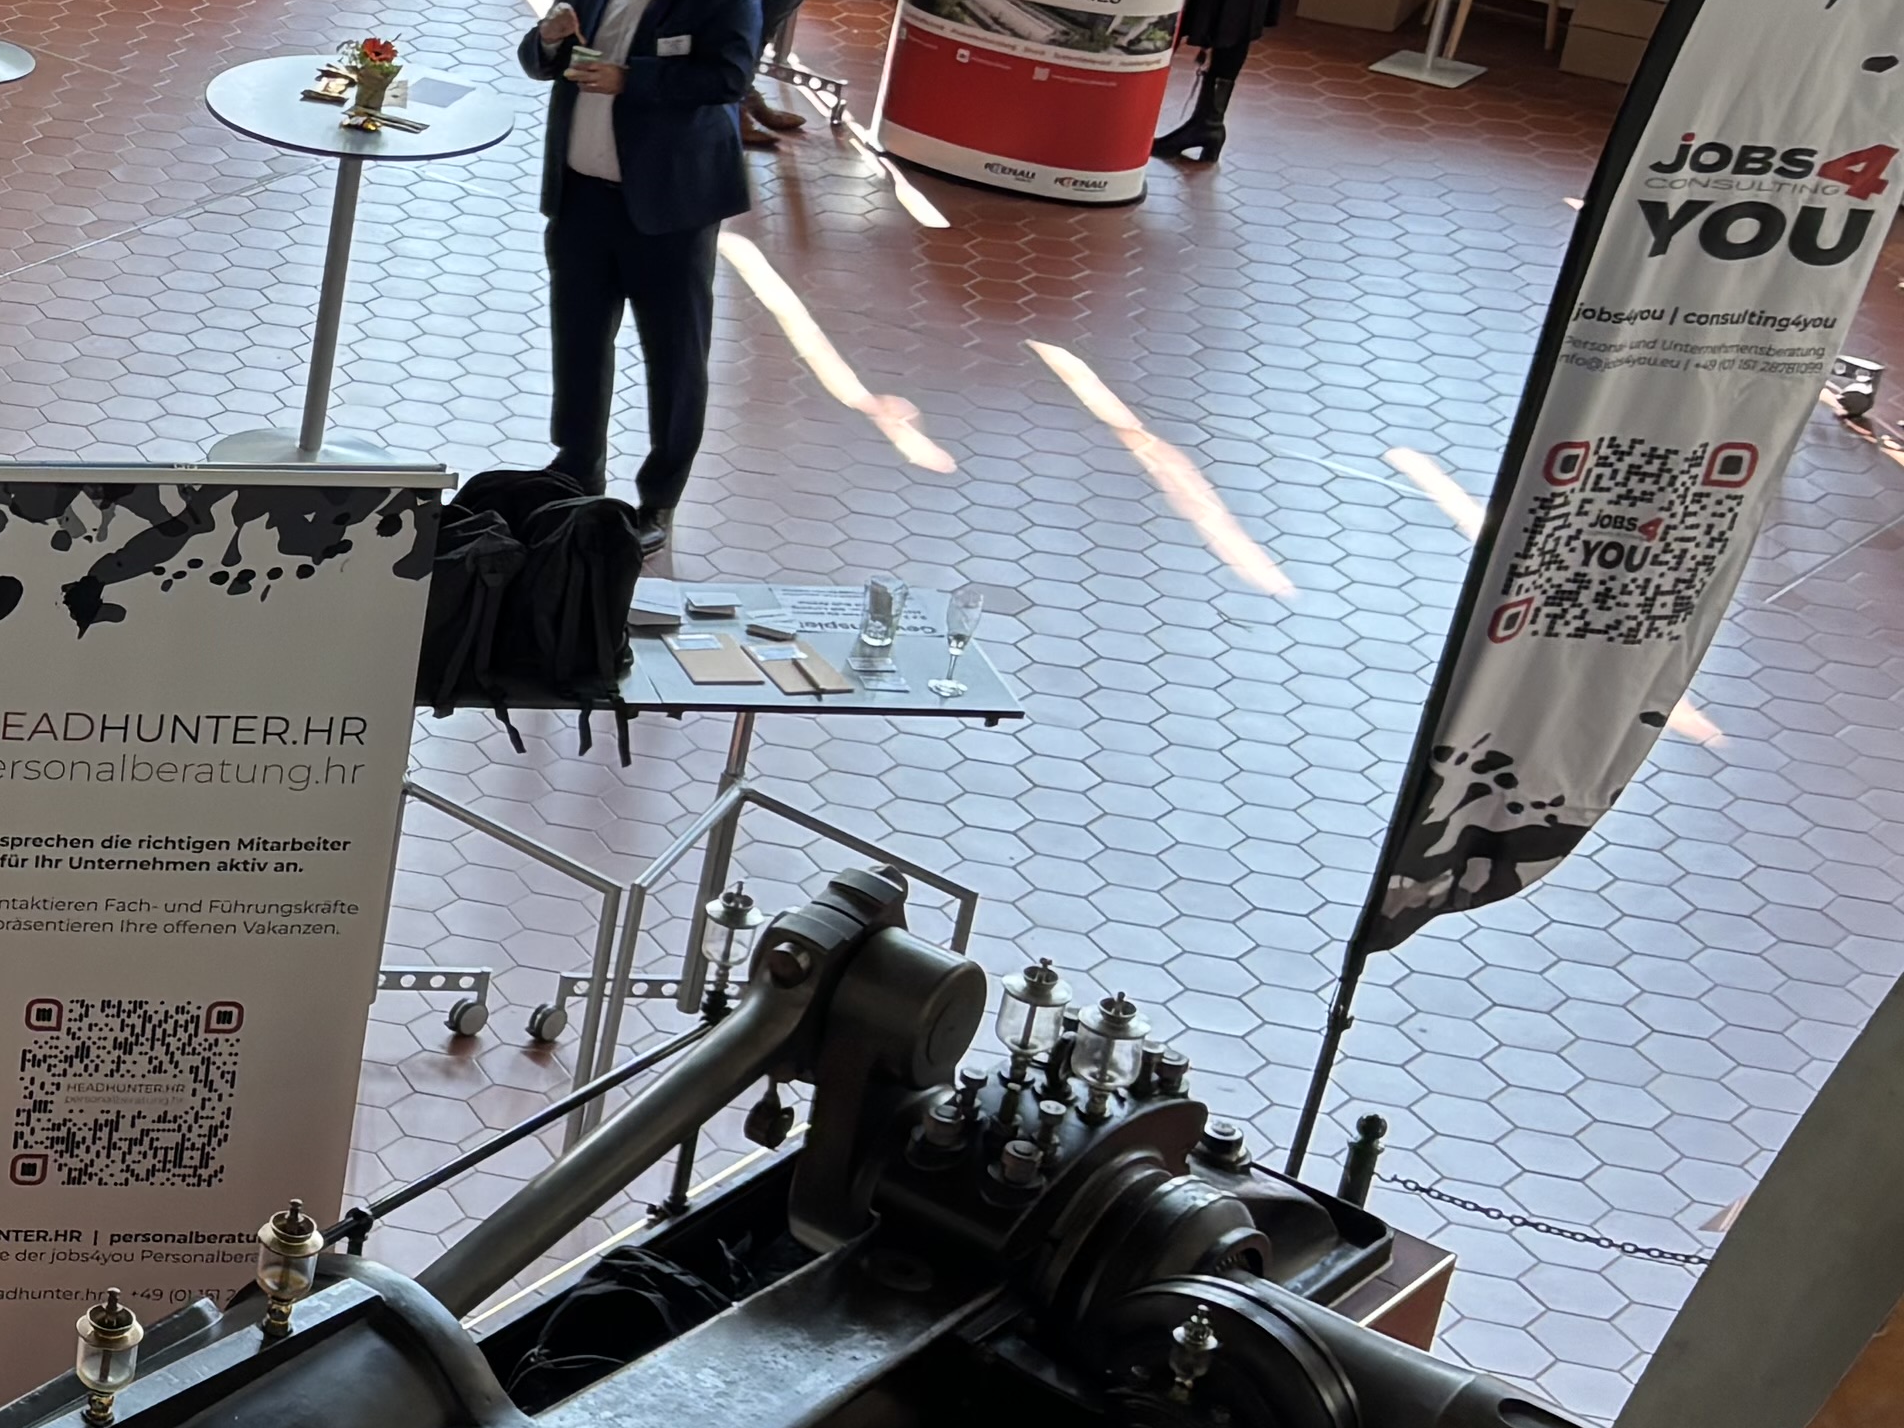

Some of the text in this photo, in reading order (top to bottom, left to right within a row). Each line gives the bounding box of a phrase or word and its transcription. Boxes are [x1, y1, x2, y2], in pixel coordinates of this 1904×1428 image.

[1643, 176, 1840, 197] CONSULTING
[1637, 199, 1875, 267] YOU
[1683, 309, 1837, 332] consulting4you
[1629, 338, 1657, 350] und
[1662, 338, 1825, 359] Unternehmensberatung
[1582, 540, 1651, 573] YOU
[0, 833, 94, 854] sprechen
[100, 834, 132, 850] die
[138, 834, 230, 855] richtigen
[238, 836, 351, 852] Mitarbeiter
[0, 853, 304, 873] für Ihr Unternehmen aktiv an.
[105, 897, 158, 913] Fach-
[164, 899, 202, 914] und
[209, 899, 359, 918] Führungskräfte
[120, 919, 157, 933] Ihre
[163, 919, 237, 935] offenen
[244, 921, 341, 936] Vakanzen.
[66, 1082, 185, 1093] HEADHUNTER.HR
[15, 1249, 45, 1262] der
[48, 1248, 134, 1266] jobs4you
[131, 1288, 163, 1302] +49
